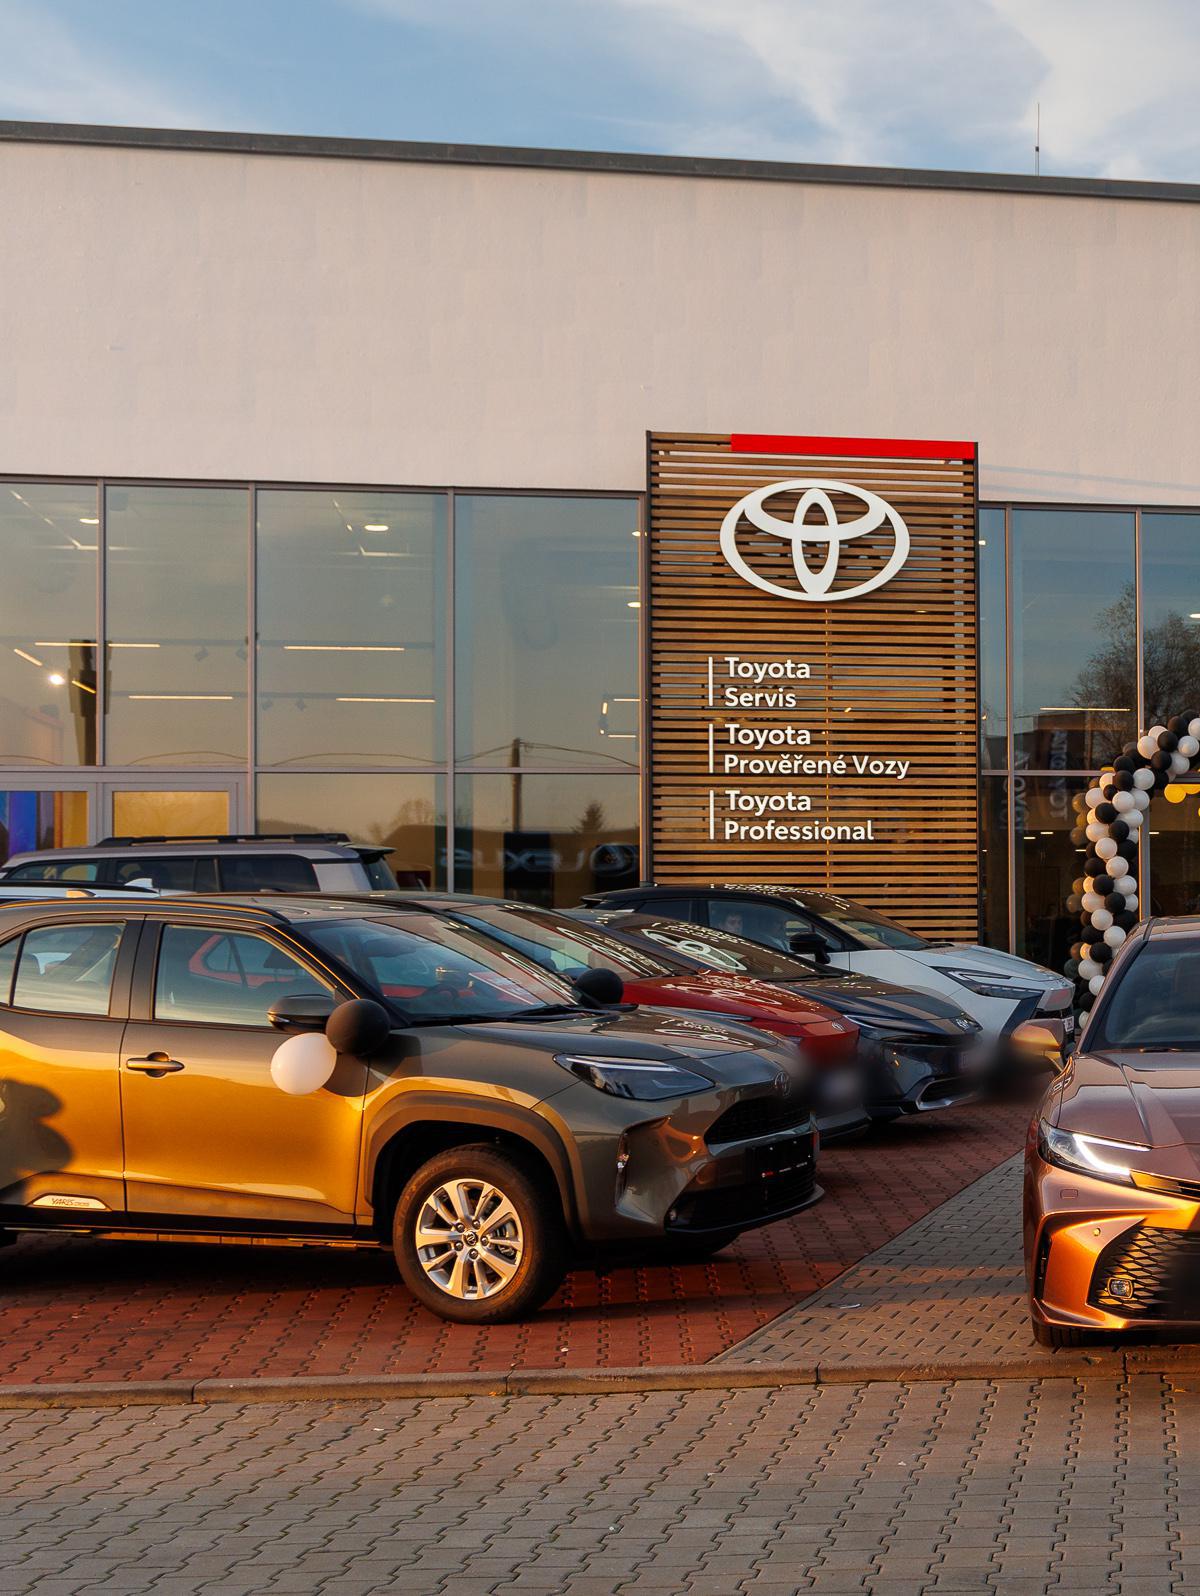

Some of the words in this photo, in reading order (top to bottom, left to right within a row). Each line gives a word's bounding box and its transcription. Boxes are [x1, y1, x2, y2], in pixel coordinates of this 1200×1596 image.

[724, 656, 811, 684] Toyota
[724, 687, 797, 708] Servis
[724, 723, 811, 750] Toyota
[724, 753, 847, 775] Prověřené
[852, 755, 910, 780] Vozy
[724, 789, 811, 817] Toyota
[724, 820, 874, 841] Professional
